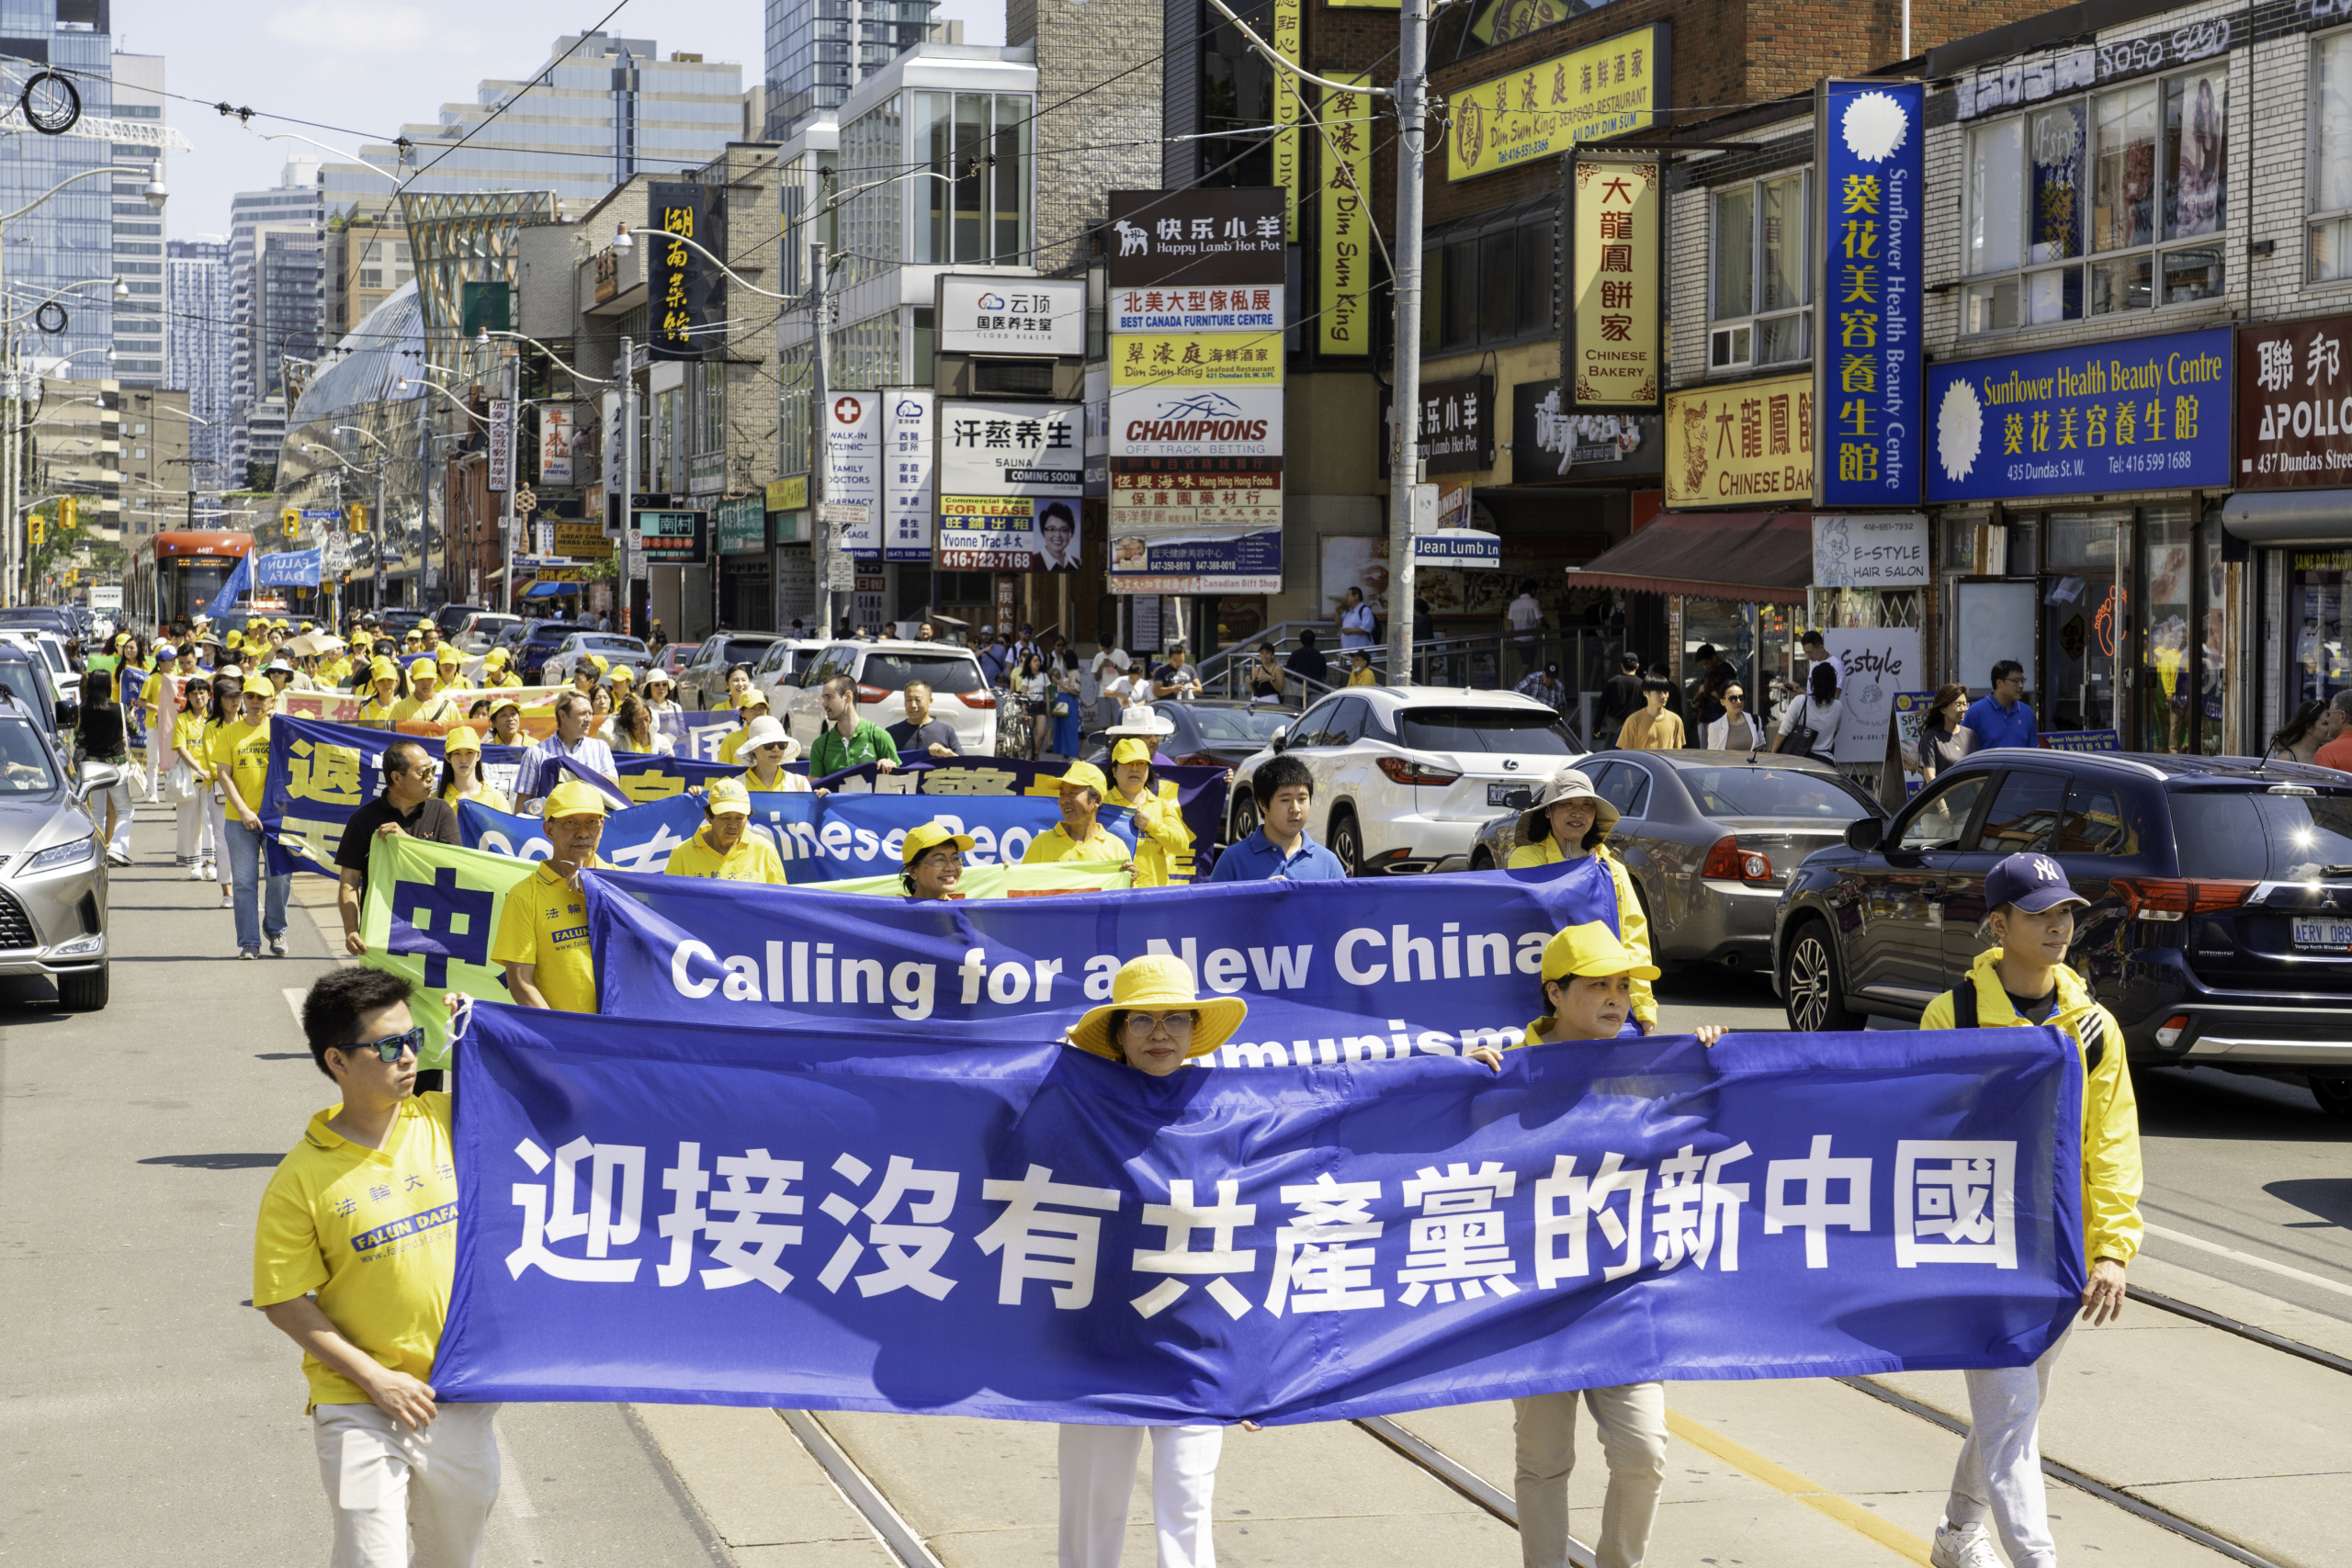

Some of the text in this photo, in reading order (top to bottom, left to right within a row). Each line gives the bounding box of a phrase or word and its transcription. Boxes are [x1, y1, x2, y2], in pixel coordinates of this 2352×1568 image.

[1490, 86, 1646, 148] Dim Sum King SEAFOOD RESTAURANT
[1585, 112, 1636, 141] DAY DIM SUM
[1279, 105, 1293, 190] DAY DIM
[1157, 216, 1281, 240] 快乐小羊
[1157, 240, 1281, 255] Happy Lamb Hot Pot
[1600, 177, 1633, 341] 大龍鳳餅家
[1331, 196, 1358, 342] Dim Sum King
[1011, 294, 1050, 313] 云顶
[1125, 289, 1271, 312] 北美大型傢俬展
[978, 316, 1052, 331] 国医养生堂
[1121, 313, 1273, 328] BEST CANADA FURNITURE CENTRE
[1838, 175, 1882, 481] 葵花美容養生館
[1883, 168, 1908, 490] Sunflower Health Beauty Centre
[1126, 342, 1268, 365] 翠濠庭 海鮮酒家
[2257, 332, 2340, 392] 聯邦
[1124, 365, 1203, 378] Dim Sum King
[1984, 351, 2222, 406] Sunflower Health Beauty Centre
[1126, 420, 1268, 441] CHAMPIONS
[2004, 394, 2199, 456] 葵花美容養生館
[899, 432, 919, 441] 西醫
[955, 420, 1072, 448] 汗蒸养生
[832, 443, 863, 451] CLINIC
[899, 443, 919, 452] 診所
[1125, 444, 1265, 454] OFF TRACK BETTING
[1431, 434, 1477, 455] Lamb Hot Pot
[832, 465, 864, 473] FAMILY
[899, 463, 919, 473] 家庭
[995, 458, 1033, 468] SAUNA
[2109, 451, 2191, 473] Tel: 416 599 1688
[2257, 451, 2323, 473] 437 Dundas
[1012, 471, 1076, 482] COMING SOON
[2007, 461, 2059, 480] 435 Dundas
[899, 474, 919, 483] 醫生
[1199, 475, 1273, 488] Hang Hing Hong Foods
[899, 497, 919, 506] 藥房
[1131, 491, 1261, 505] 保康園藥材行
[945, 504, 1030, 515] FOR LEASE
[899, 518, 920, 528] 養生
[945, 517, 1029, 530] 旺鋪出租
[1863, 523, 1914, 531] 416-551-7332
[899, 529, 920, 539] 醫美
[943, 533, 1001, 547] Yvonne Trac
[854, 549, 876, 558] Health
[887, 550, 903, 558] (647)
[1417, 540, 1498, 555] Jean Lumb Ln
[1854, 546, 1920, 560] E-STYLE
[331, 560, 342, 569] 40
[1195, 561, 1236, 570] 647-388-0018
[2295, 554, 2330, 570] SAME DAY
[538, 570, 556, 581] SPA
[1853, 566, 1924, 578] HAIR SALON
[1203, 579, 1278, 590] Canadian Gift Shop
[1856, 717, 1870, 727] HAIR
[2082, 734, 2098, 742] Beauty
[238, 747, 260, 755] FALUN
[2032, 858, 2059, 881] NY
[387, 867, 494, 988] 中
[2296, 925, 2352, 942] AERV 089
[671, 921, 1555, 1021] Calling for a New China
[334, 1162, 454, 1219] 法輪大法
[356, 1204, 458, 1249] FALUN DAFA
[504, 1134, 2019, 1322] 迎接沒有共產黨的新中國
[359, 1228, 453, 1264] www.falundafa.org
